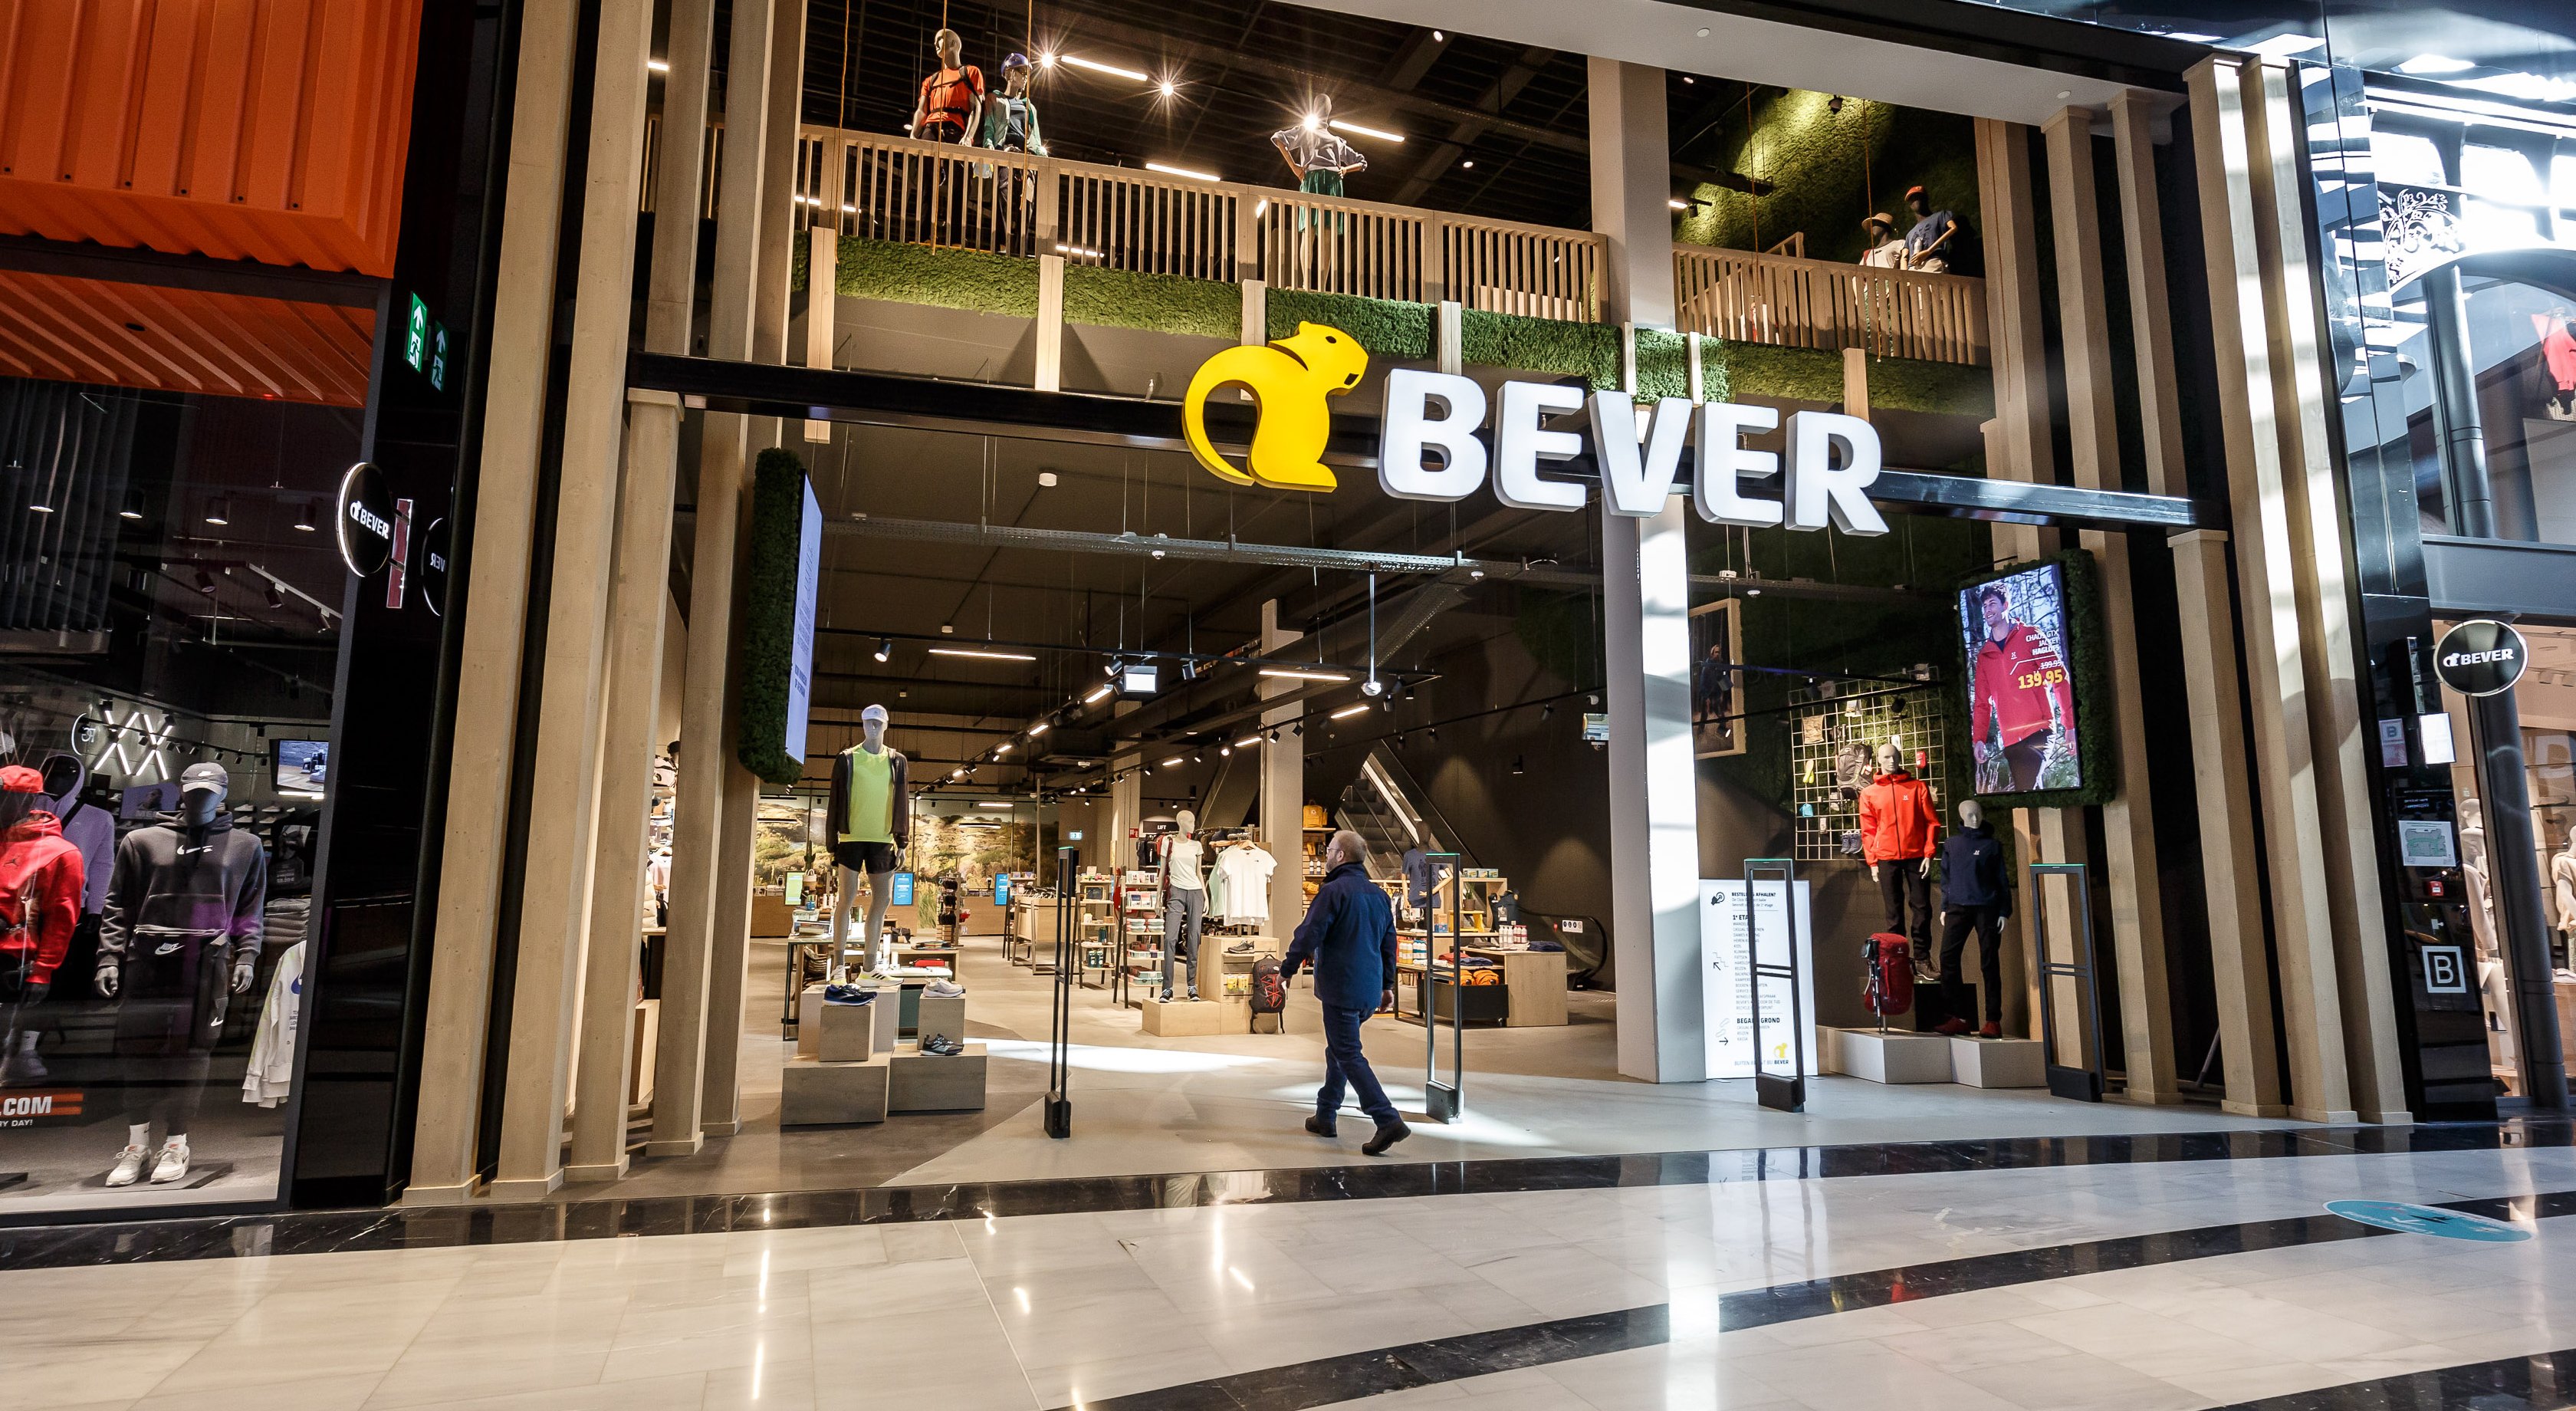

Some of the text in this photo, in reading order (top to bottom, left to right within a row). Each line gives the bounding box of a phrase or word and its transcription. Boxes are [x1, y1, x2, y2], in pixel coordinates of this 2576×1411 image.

[1379, 367, 1890, 537] BEVER
[360, 508, 389, 540] BEVER
[2039, 638, 2059, 647] JACKET
[2046, 630, 2059, 638] GTX
[2460, 648, 2515, 666] BEVER
[2017, 669, 2063, 689] 139.95
[2433, 955, 2454, 984] B
